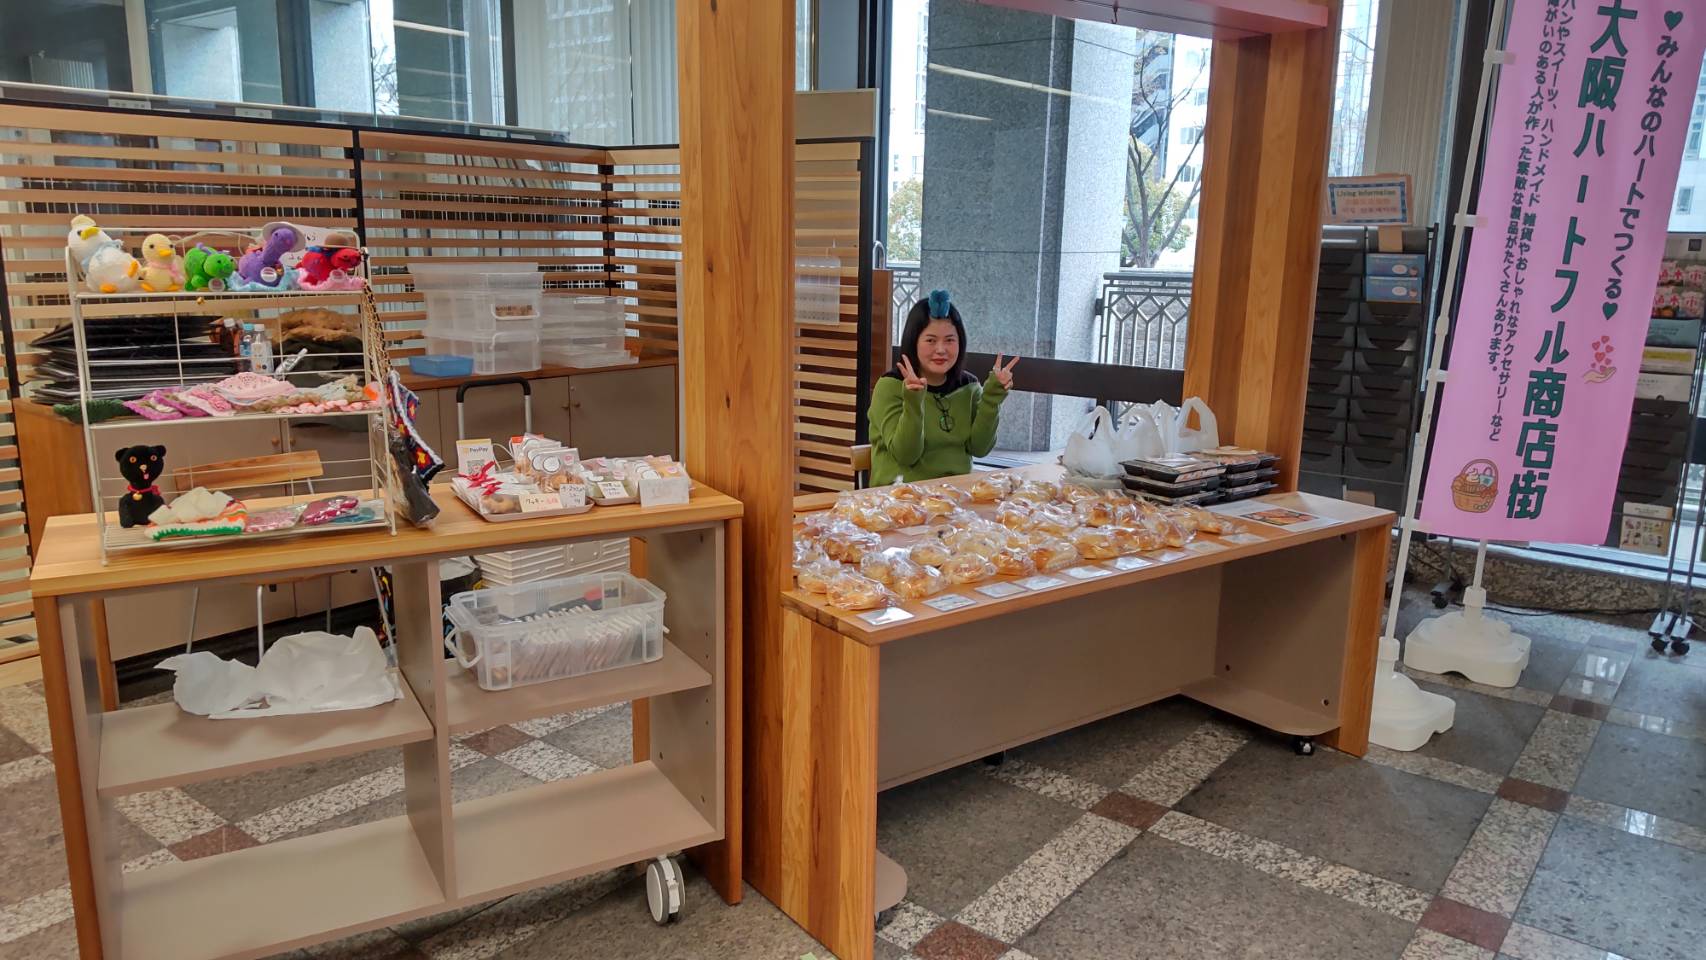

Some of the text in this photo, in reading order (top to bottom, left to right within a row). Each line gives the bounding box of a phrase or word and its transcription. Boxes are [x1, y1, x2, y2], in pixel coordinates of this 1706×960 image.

[1506, 0, 1638, 520] 大阪ハートフル商店街
[469, 446, 489, 454] PayPay
